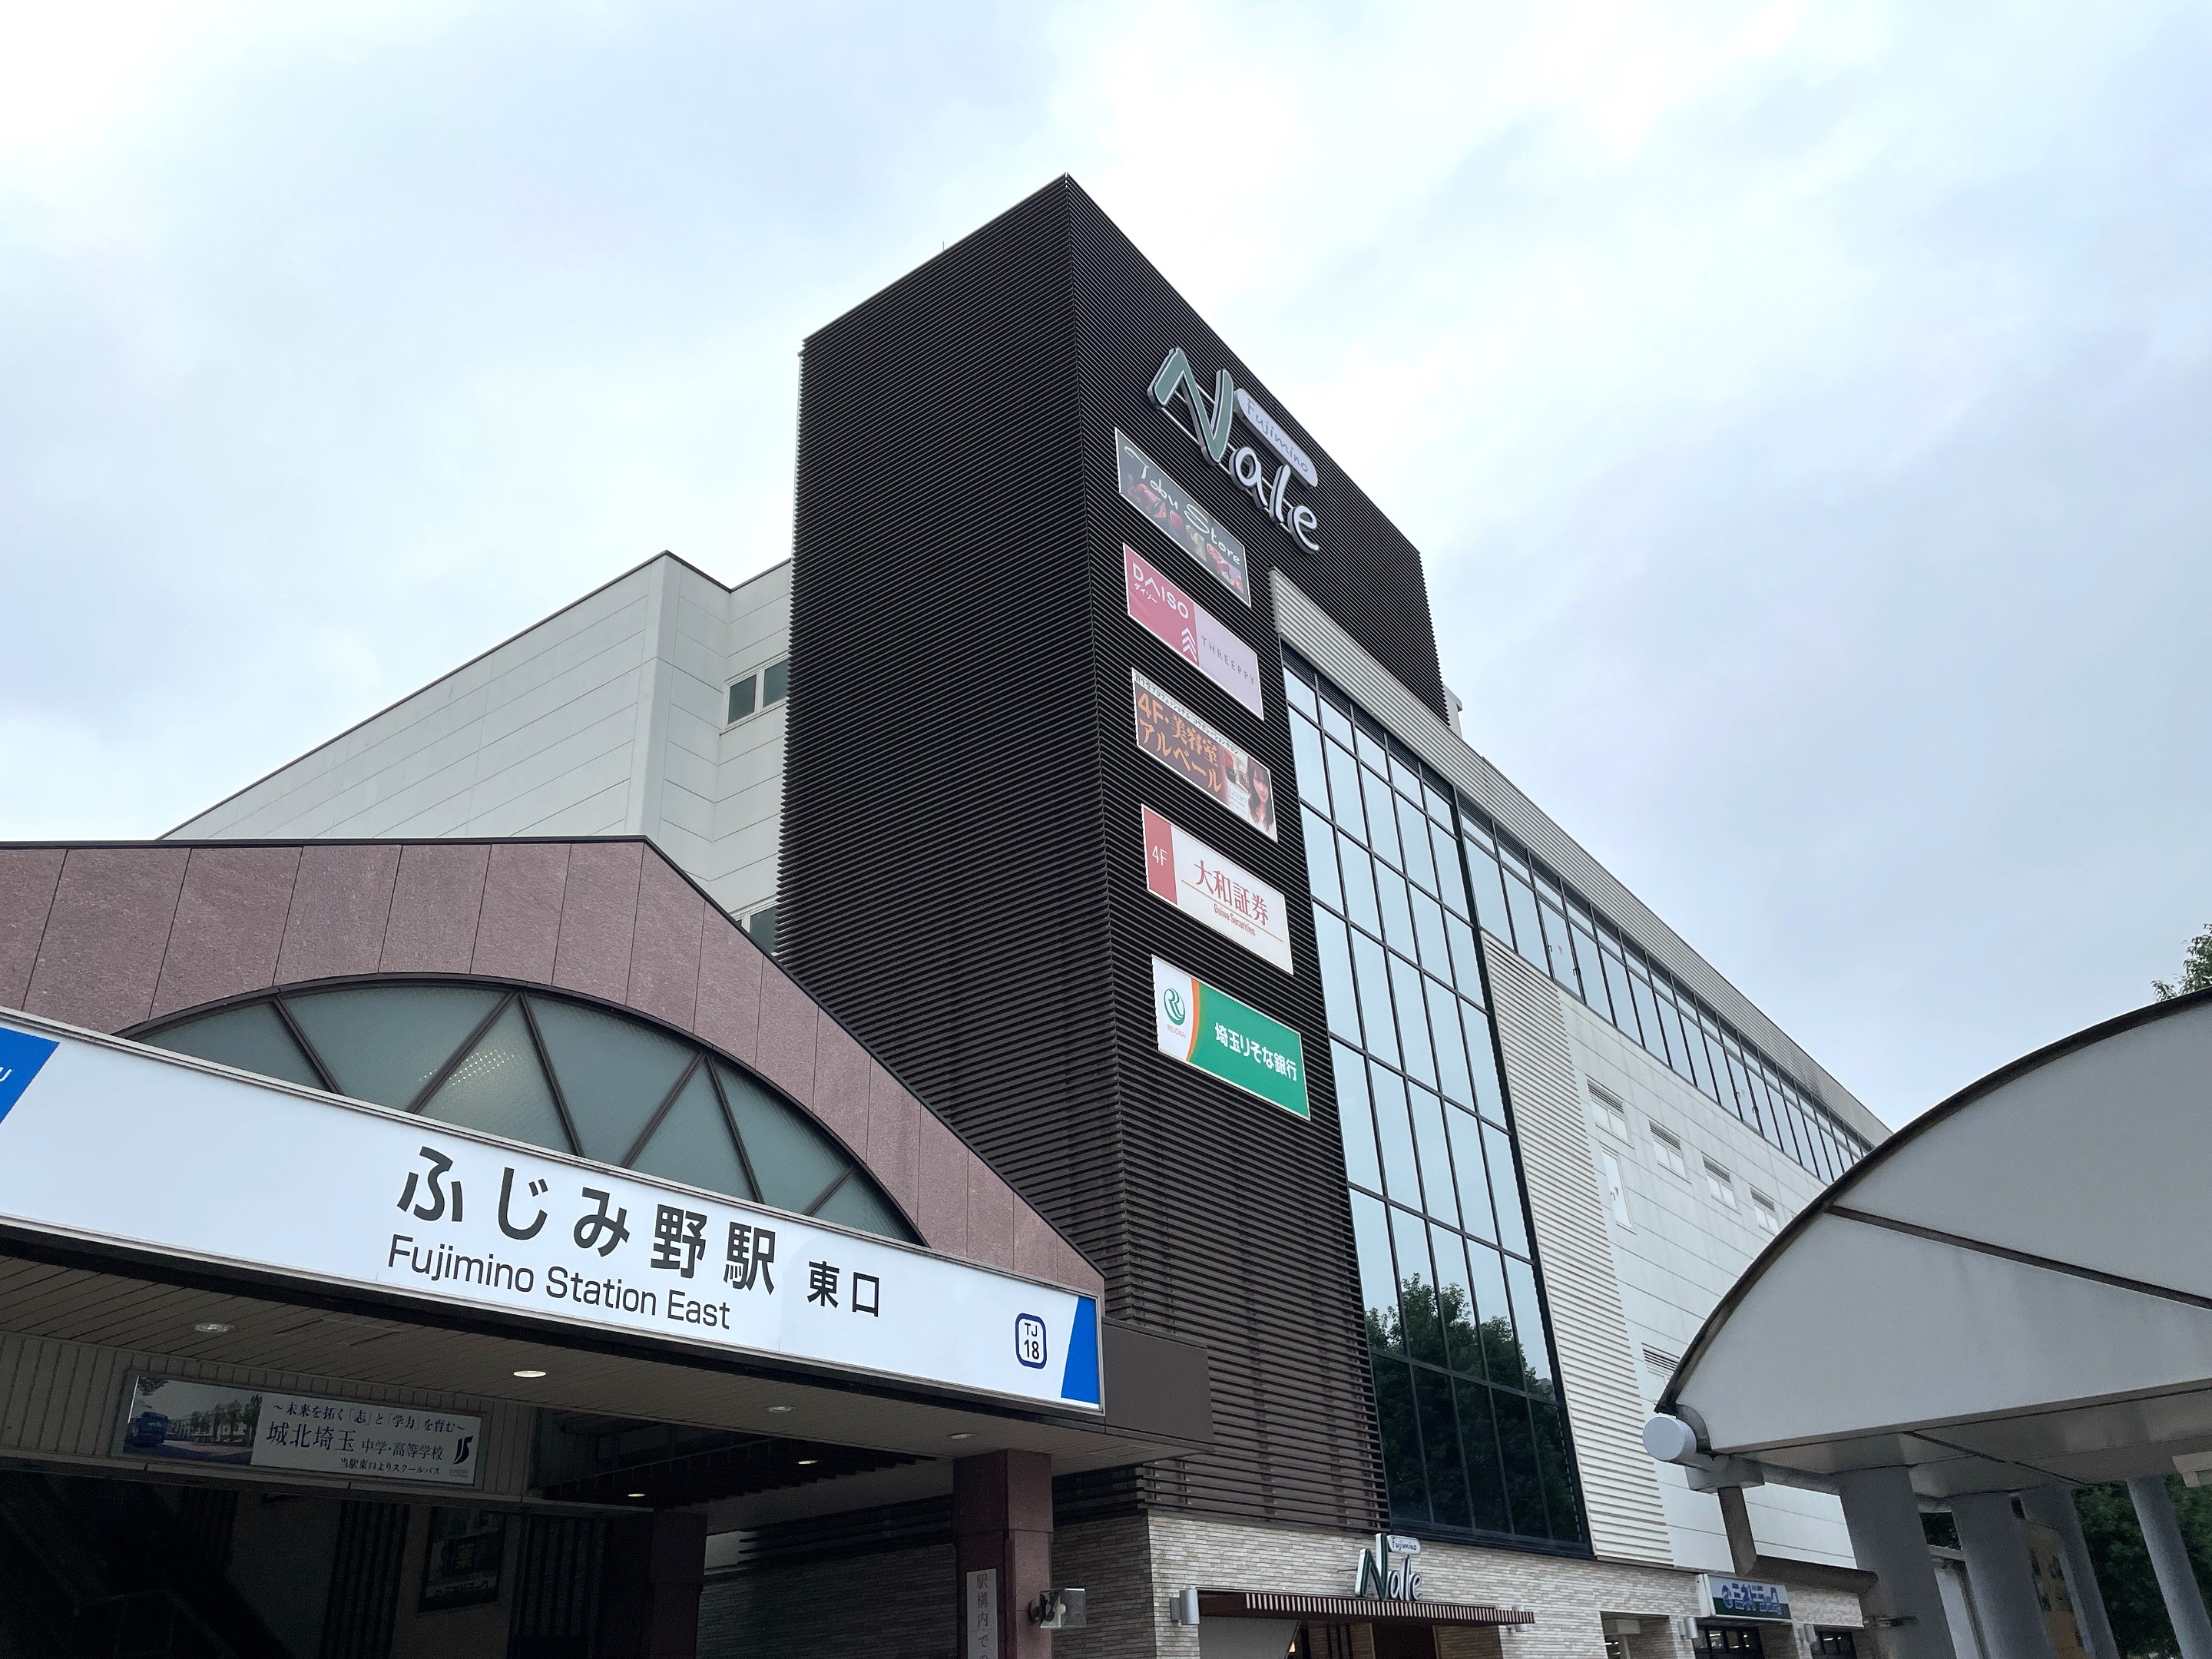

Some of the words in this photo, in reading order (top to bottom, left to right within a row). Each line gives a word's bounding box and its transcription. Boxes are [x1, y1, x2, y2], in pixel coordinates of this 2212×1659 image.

[1246, 397, 1309, 473] Fujimino
[1124, 445, 1179, 511] Tobu
[1184, 503, 1241, 565] Store
[1132, 561, 1190, 620] DAISO
[1134, 582, 1157, 604] ダイソー
[1200, 635, 1256, 685] THREEPPY
[1140, 720, 1223, 793] アルベール
[1151, 845, 1168, 866] 4F
[1194, 859, 1270, 926] 大和証券
[1214, 902, 1230, 922] Daiwa
[1230, 912, 1256, 937] Securities
[1167, 1024, 1187, 1039] RESONA
[1214, 1022, 1297, 1082] 埼玉りそな銀行
[396, 1145, 776, 1296] ふじみ野駅
[806, 1260, 882, 1318] 東口
[388, 1233, 535, 1293] Fujimino
[546, 1265, 657, 1316] Station
[667, 1290, 731, 1330] East
[1023, 1339, 1040, 1361] 18
[1024, 1322, 1038, 1338] TJ
[266, 1421, 357, 1452] 城北埼玉
[361, 1439, 444, 1461] 中学・高等学校
[340, 1457, 441, 1476] 当駅東口よりスクールバス
[1392, 1537, 1418, 1551] Fujimino
